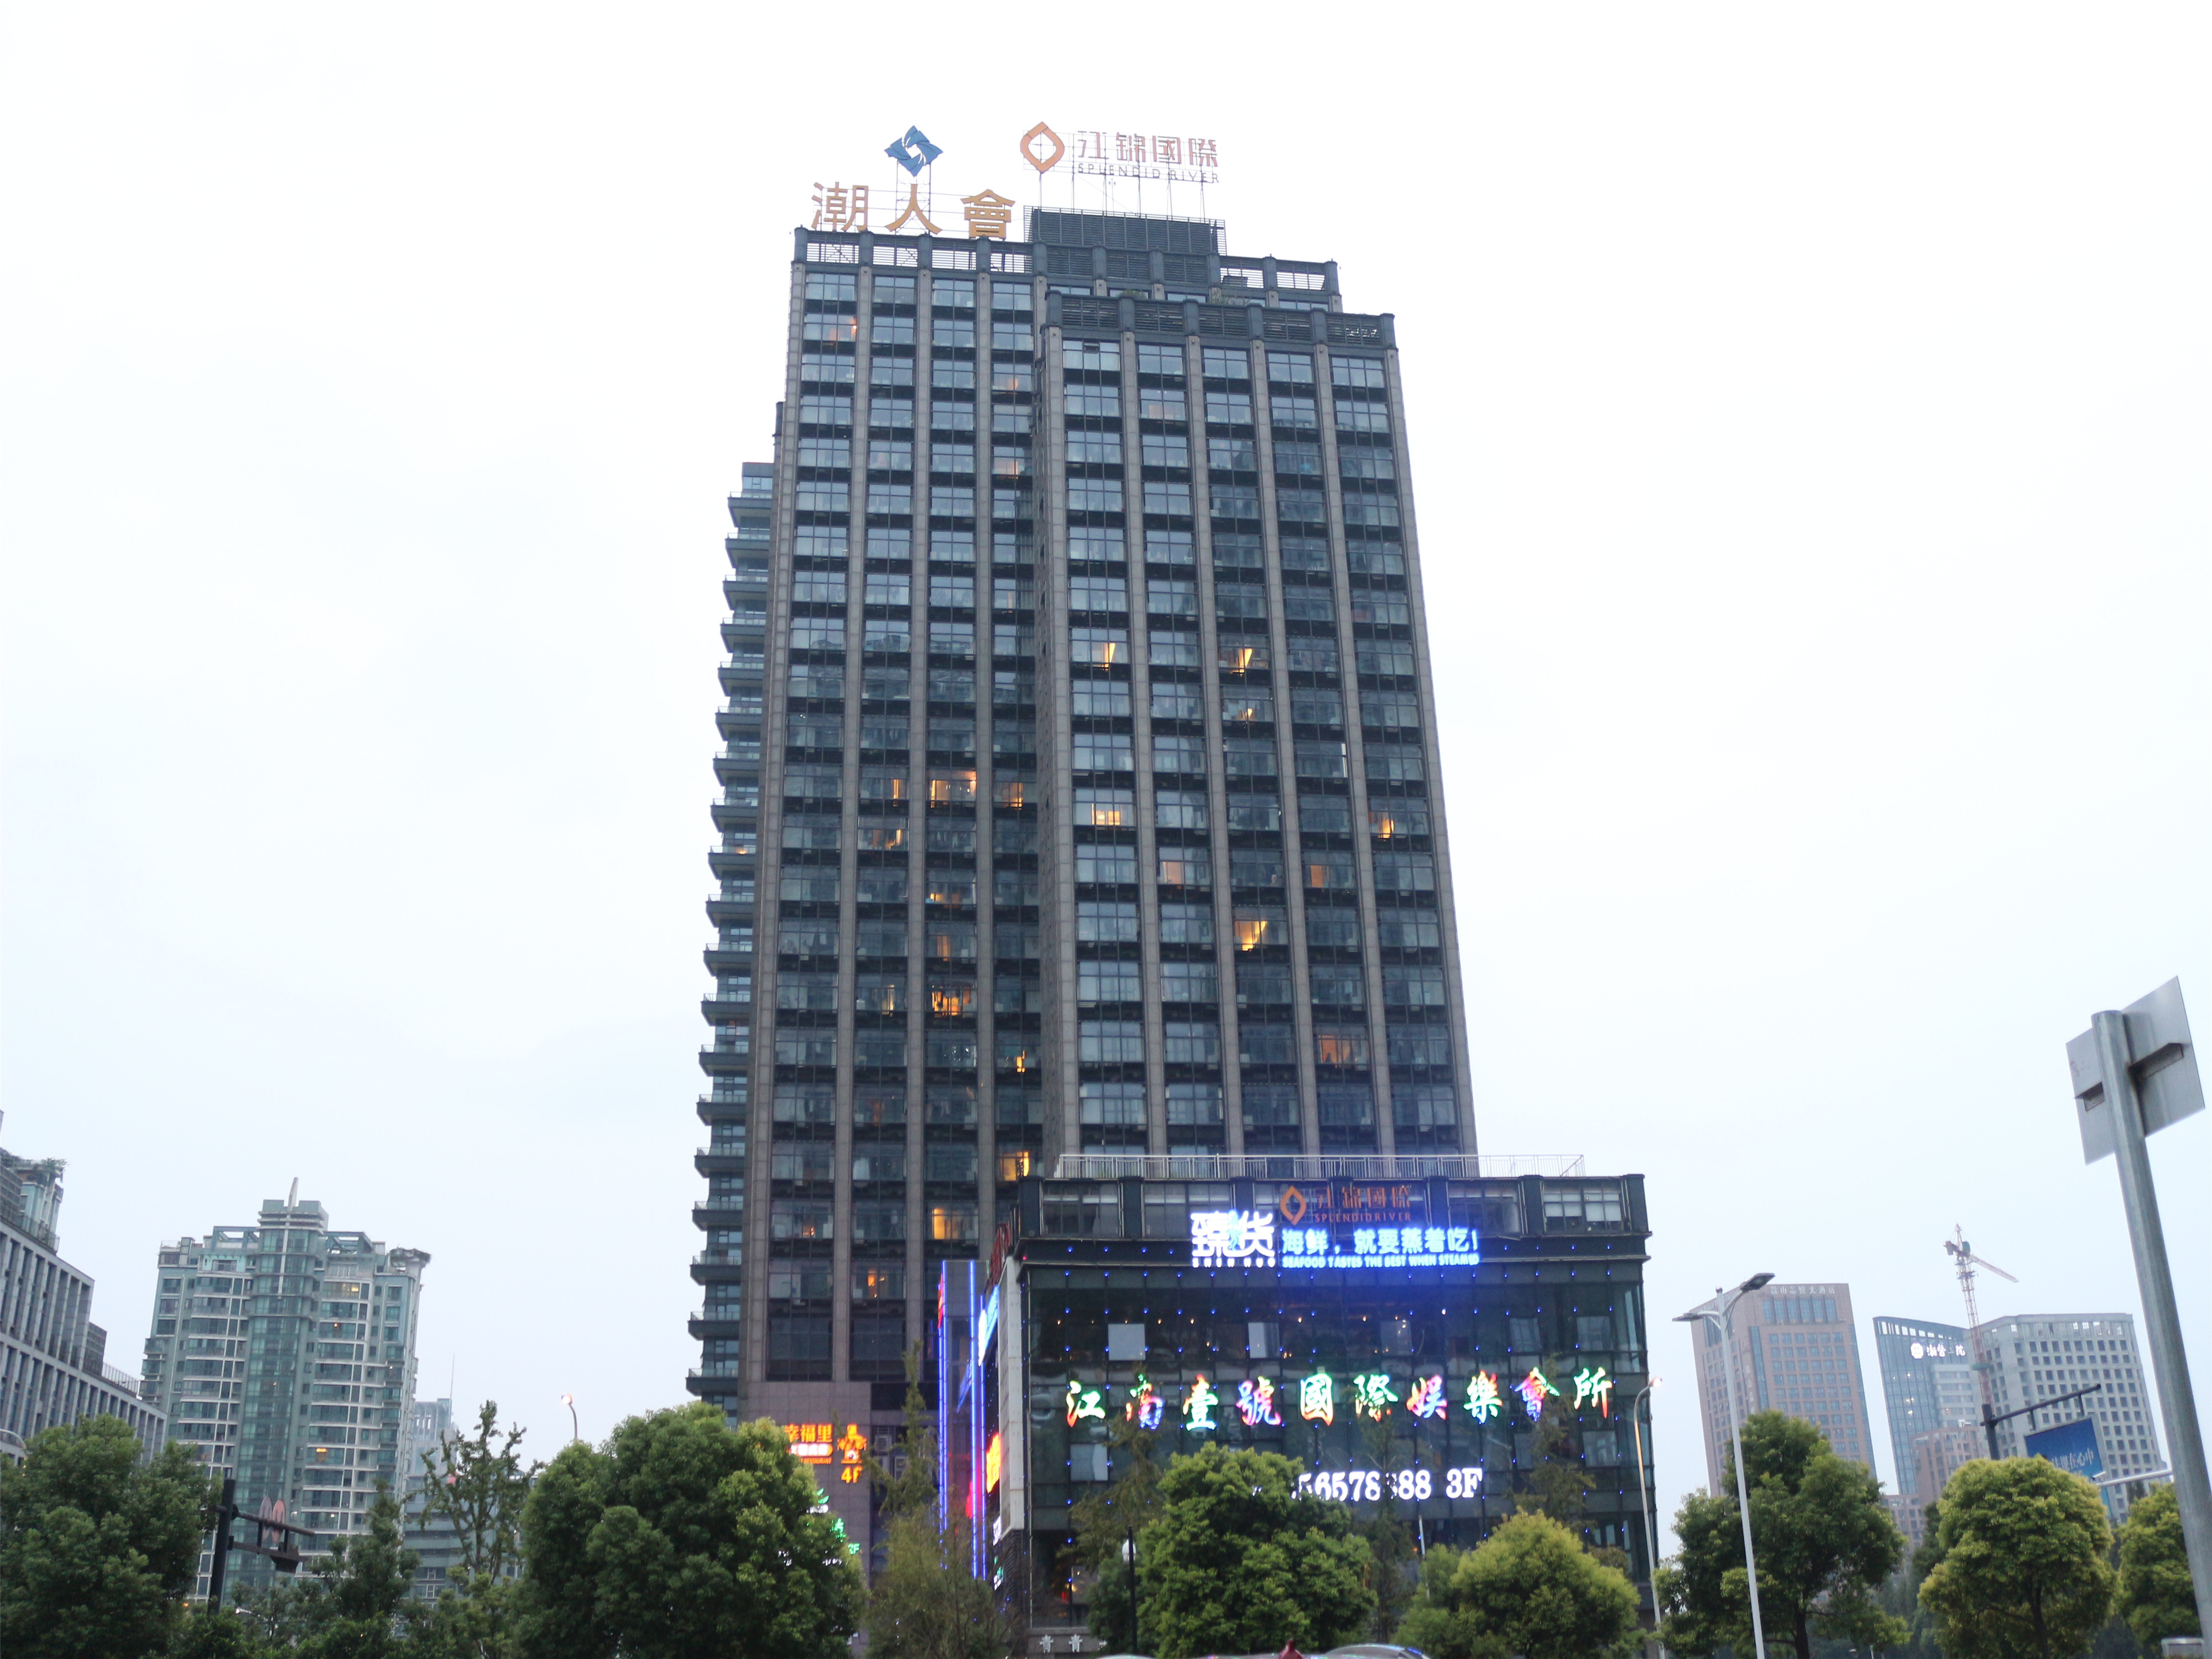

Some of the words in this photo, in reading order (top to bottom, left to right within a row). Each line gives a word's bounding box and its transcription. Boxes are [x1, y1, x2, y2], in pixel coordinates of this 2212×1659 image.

[1078, 163, 1160, 179] SPLENDID
[1170, 170, 1219, 183] RIVER
[811, 181, 1016, 239] 潮人會
[1282, 1255, 1326, 1268] SEAFOOD
[1328, 1255, 1363, 1268] TASTES
[1364, 1255, 1383, 1267] THE
[1384, 1255, 1406, 1267] BEST
[1408, 1254, 1437, 1266] WHEN
[841, 1467, 863, 1483] 4F
[1446, 1467, 1483, 1499] 3F
